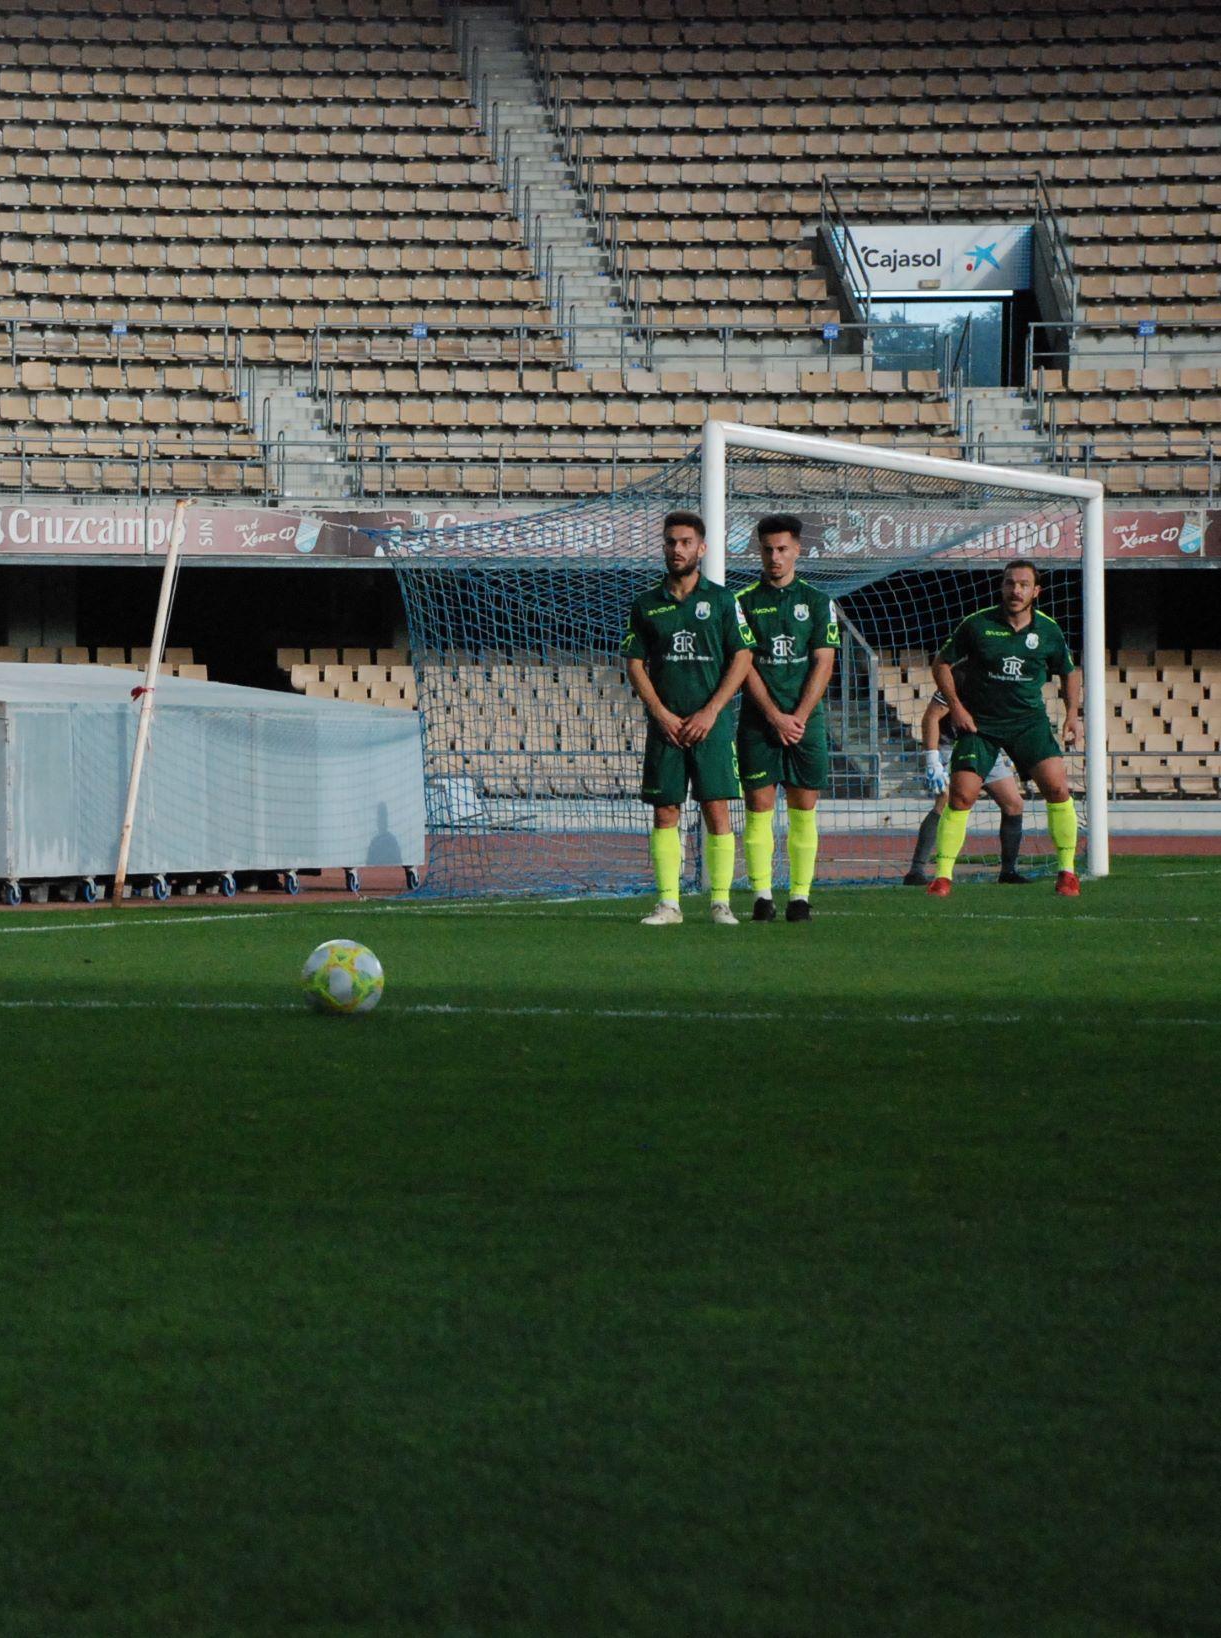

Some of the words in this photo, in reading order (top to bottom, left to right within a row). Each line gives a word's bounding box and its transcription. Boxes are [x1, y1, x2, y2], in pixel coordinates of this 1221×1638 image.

[863, 248, 941, 273] Cajasol
[9, 509, 186, 552] Cruzcampo
[241, 530, 277, 548] Xerez
[278, 526, 297, 540] CD
[434, 513, 614, 553] Cruzcampo
[1119, 531, 1159, 550] Xerez
[1160, 527, 1179, 541] CD
